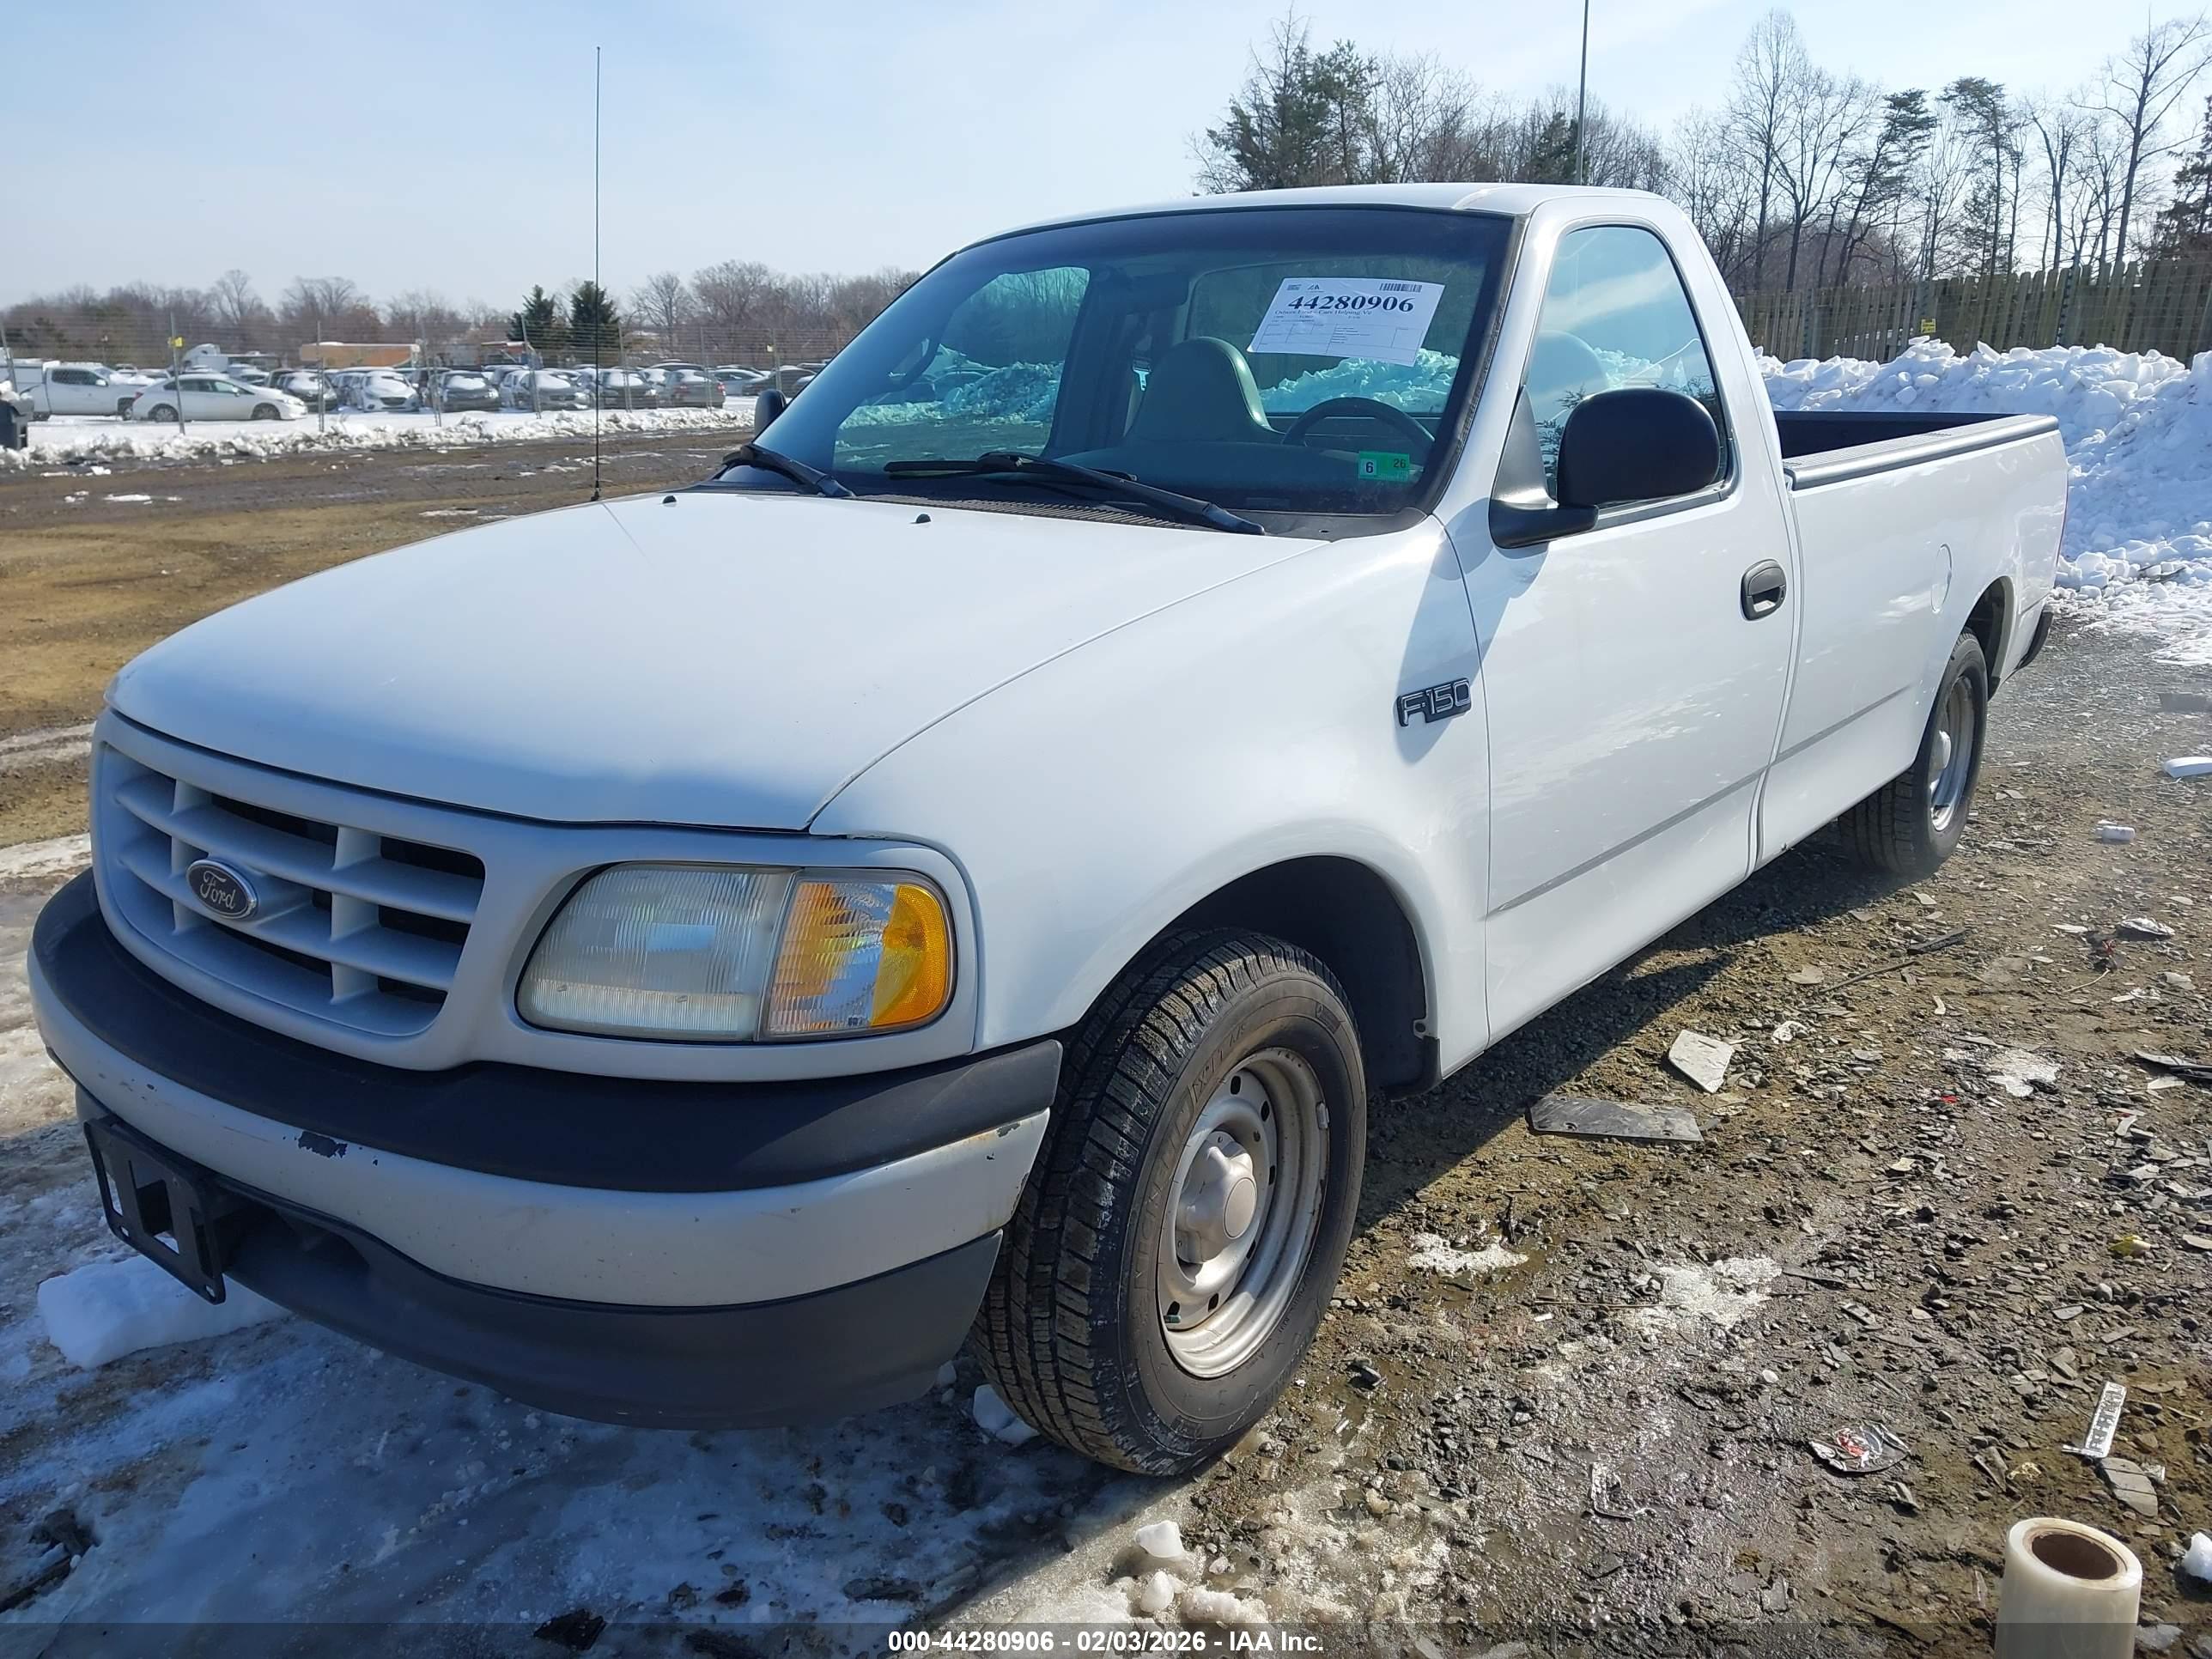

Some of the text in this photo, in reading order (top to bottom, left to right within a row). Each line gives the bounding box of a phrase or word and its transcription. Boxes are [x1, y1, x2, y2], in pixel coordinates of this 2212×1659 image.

[1288, 295, 1416, 313] 44280906
[1365, 461, 1374, 473] 6
[1393, 459, 1407, 469] 26
[1397, 678, 1472, 726] F-150
[200, 870, 237, 910] Ford
